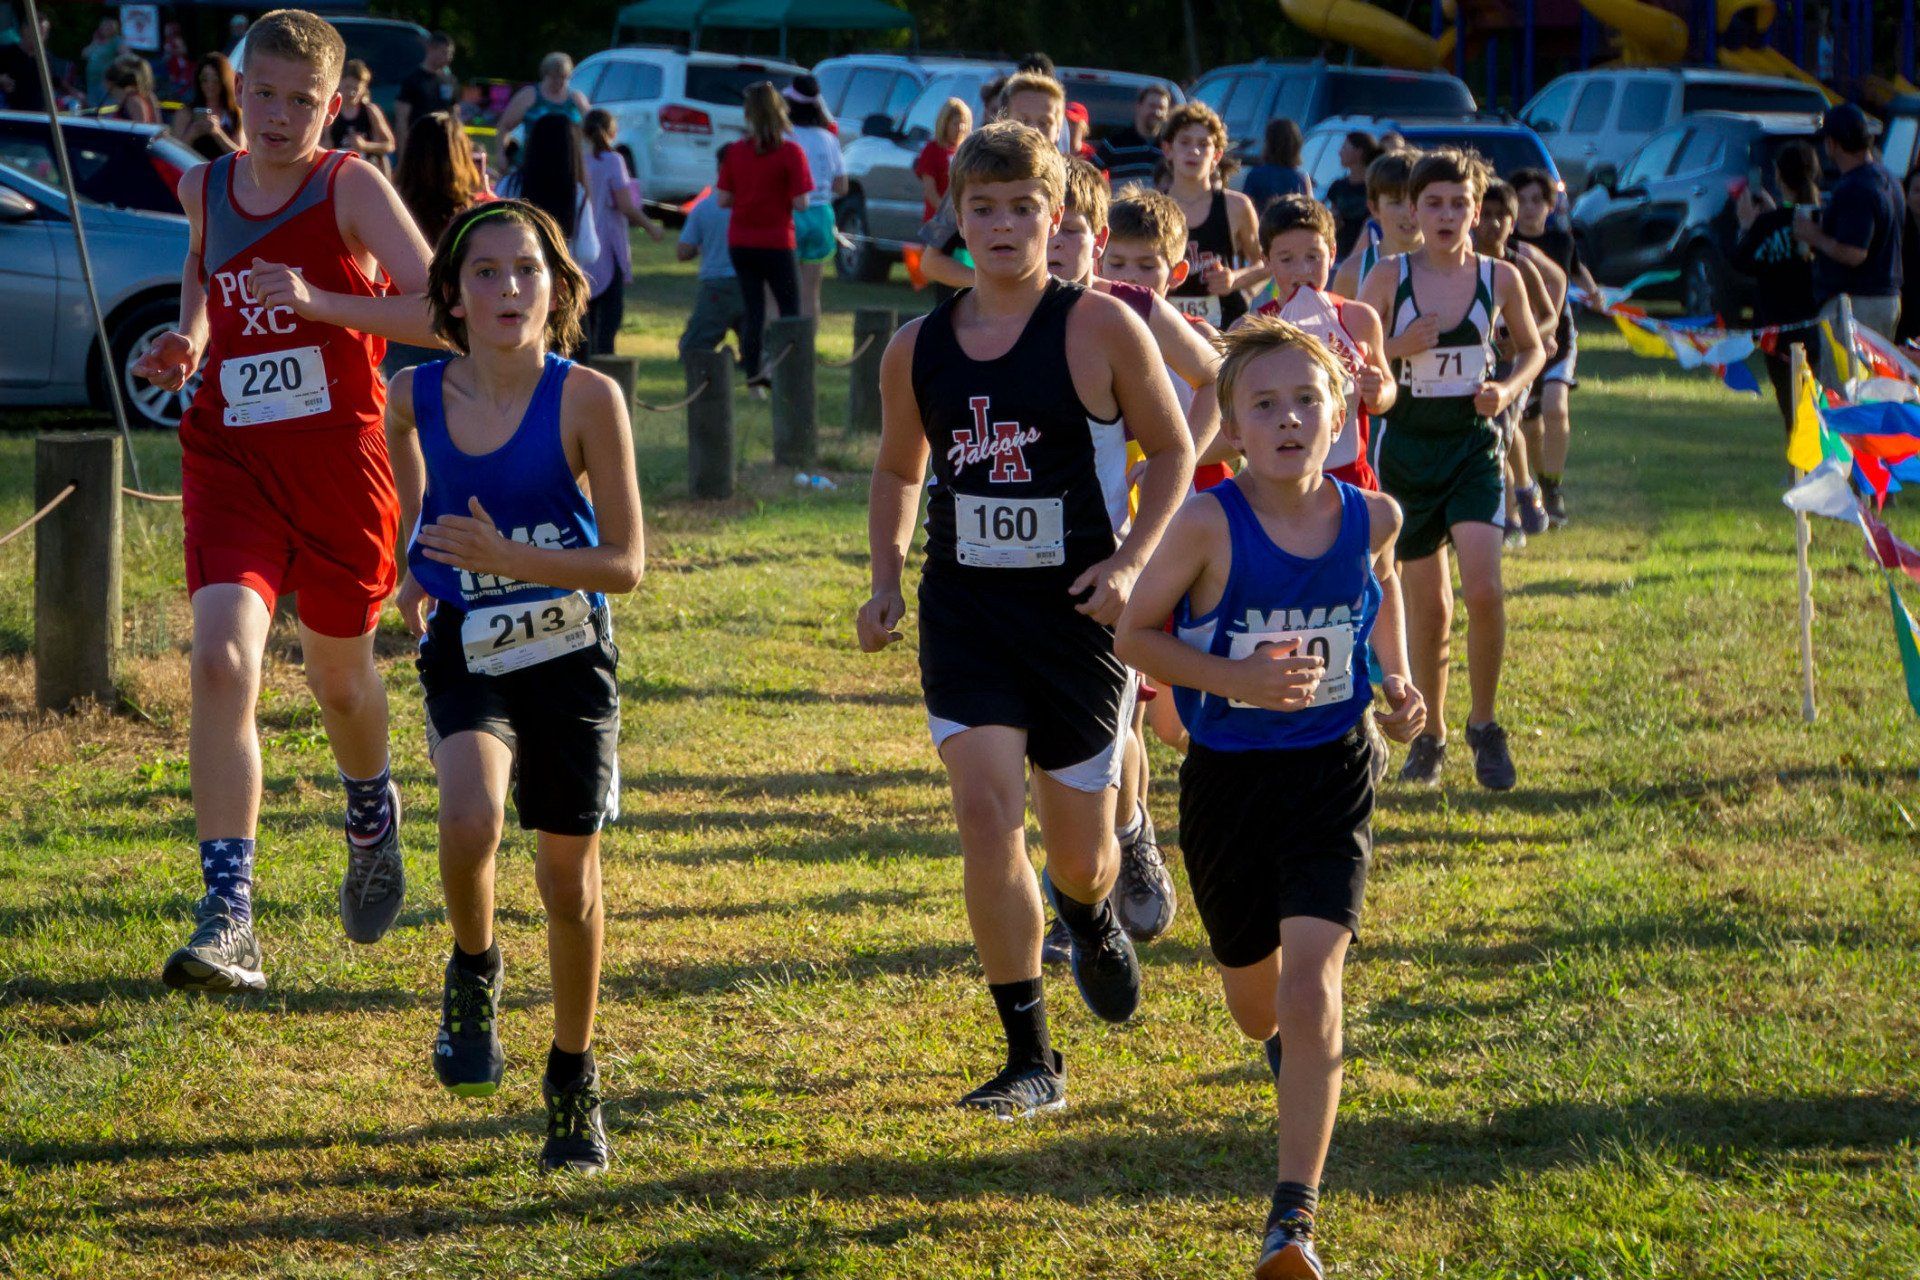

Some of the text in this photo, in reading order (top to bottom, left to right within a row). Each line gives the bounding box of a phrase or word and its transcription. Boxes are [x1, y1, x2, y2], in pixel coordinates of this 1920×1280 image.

[239, 305, 297, 336] XC
[239, 357, 302, 397] 220
[1436, 352, 1463, 377] 71
[947, 426, 1041, 477] Falcons
[974, 504, 1038, 542] 160
[489, 606, 566, 650] 213
